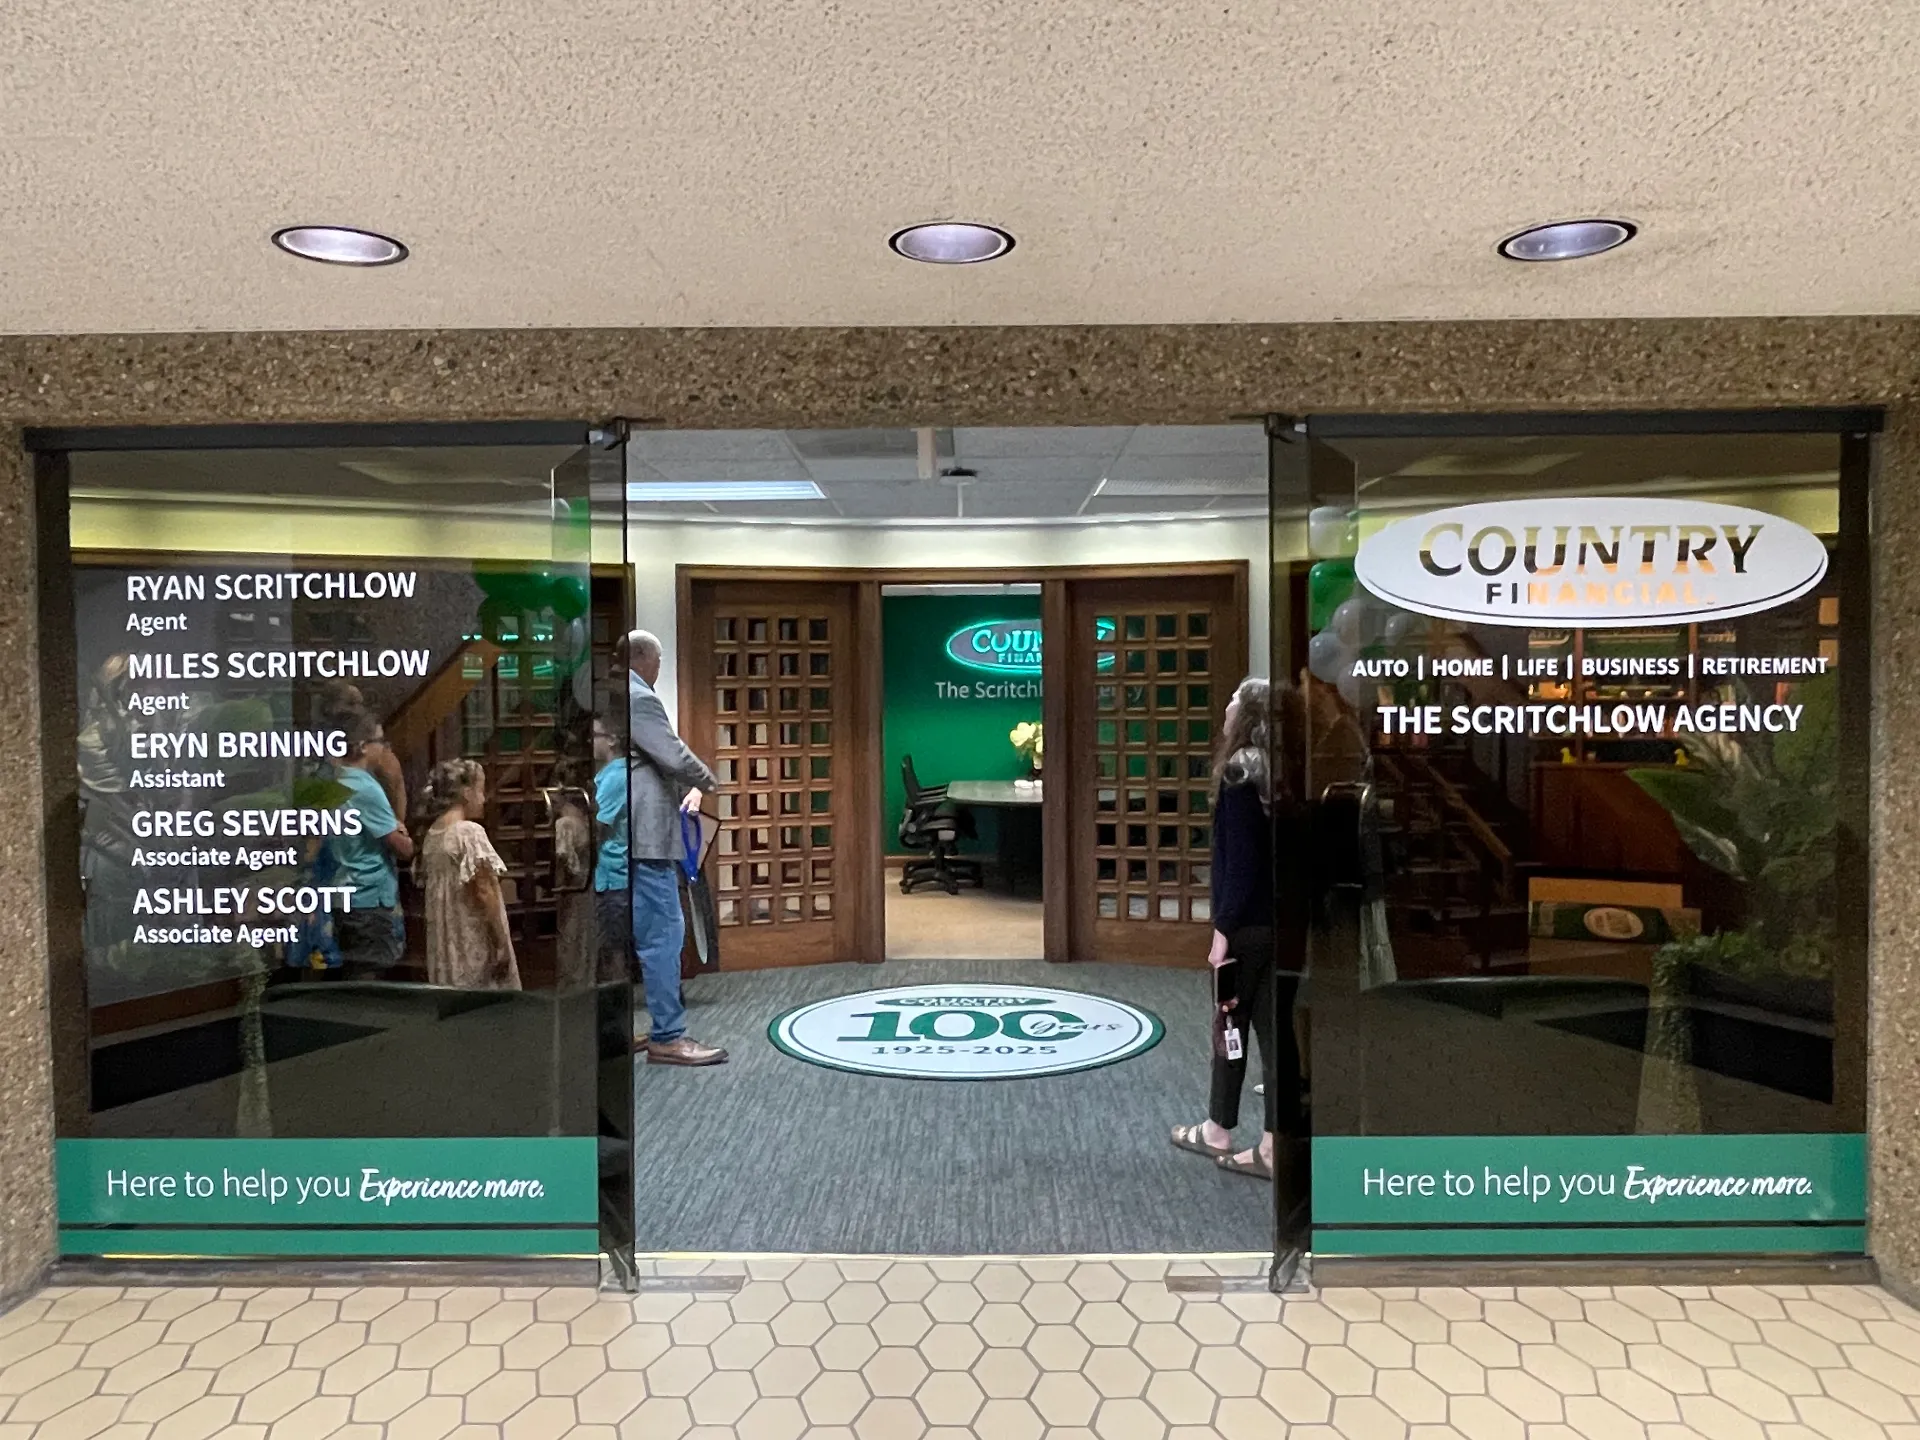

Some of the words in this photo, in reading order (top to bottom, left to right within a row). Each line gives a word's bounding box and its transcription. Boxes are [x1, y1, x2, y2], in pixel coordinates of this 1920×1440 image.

[1418, 522, 1765, 577] COUNTRY
[127, 574, 205, 601] RYAN
[215, 571, 417, 600] SCRITCHLOW
[1486, 582, 1699, 605] FINANCIAL
[126, 612, 188, 634] Agent
[129, 652, 220, 680] MILES
[227, 649, 430, 679] SCRITCHLOW
[1351, 658, 1410, 677] AUTO
[1432, 657, 1494, 677] HOME
[1516, 657, 1559, 676] LIFE
[1580, 657, 1681, 676] BUSINESS
[1702, 656, 1830, 676] RETIREMENT
[127, 692, 191, 714] Agent
[935, 681, 969, 699] The
[975, 680, 1043, 699] Scritchl
[1376, 704, 1442, 734] THE
[1450, 703, 1666, 734] SCRITCHLOW
[1671, 703, 1804, 733] AGENCY
[130, 732, 208, 759] ERYN
[218, 730, 347, 758] BRINING
[129, 768, 226, 788] Assistant
[131, 810, 215, 838] GREG
[222, 808, 363, 837] SEVERNS
[131, 845, 231, 867] Associate
[234, 846, 298, 870] Agent
[132, 887, 250, 915] ASHLEY
[256, 886, 357, 914] SCOTT
[133, 923, 233, 944] Associate
[236, 924, 299, 947] Agent
[898, 997, 1031, 1005] COUNTRY
[836, 1009, 1086, 1042] 100
[871, 1045, 1058, 1055] 1925-2025
[107, 1169, 176, 1197] Here
[184, 1171, 214, 1197] to
[223, 1167, 288, 1205] help
[295, 1176, 350, 1205] you
[359, 1168, 483, 1206] Experience
[483, 1178, 546, 1199] more.
[1363, 1168, 1436, 1196] Here
[1442, 1170, 1475, 1196] to
[1484, 1165, 1551, 1203] help
[1559, 1174, 1615, 1203] you
[1623, 1165, 1750, 1204] Experience
[1750, 1176, 1813, 1196] more.
